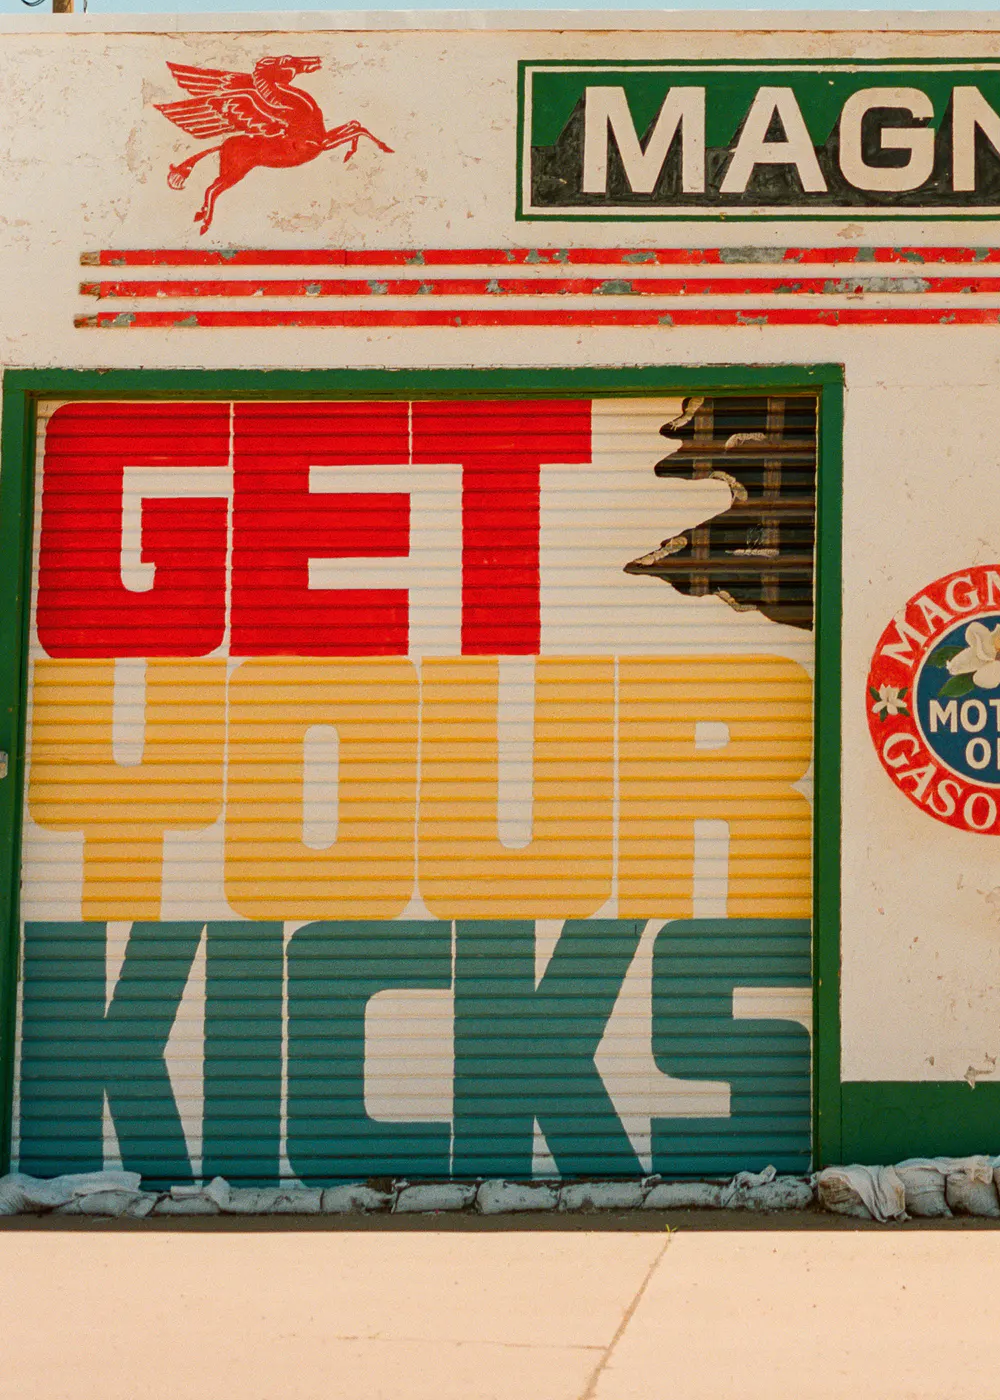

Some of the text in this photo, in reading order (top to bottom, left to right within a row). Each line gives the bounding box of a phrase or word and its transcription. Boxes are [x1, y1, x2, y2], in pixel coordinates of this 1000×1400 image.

[35, 399, 593, 659] GET
[27, 653, 814, 921] YOUR
[18, 918, 814, 1188] KICKS
